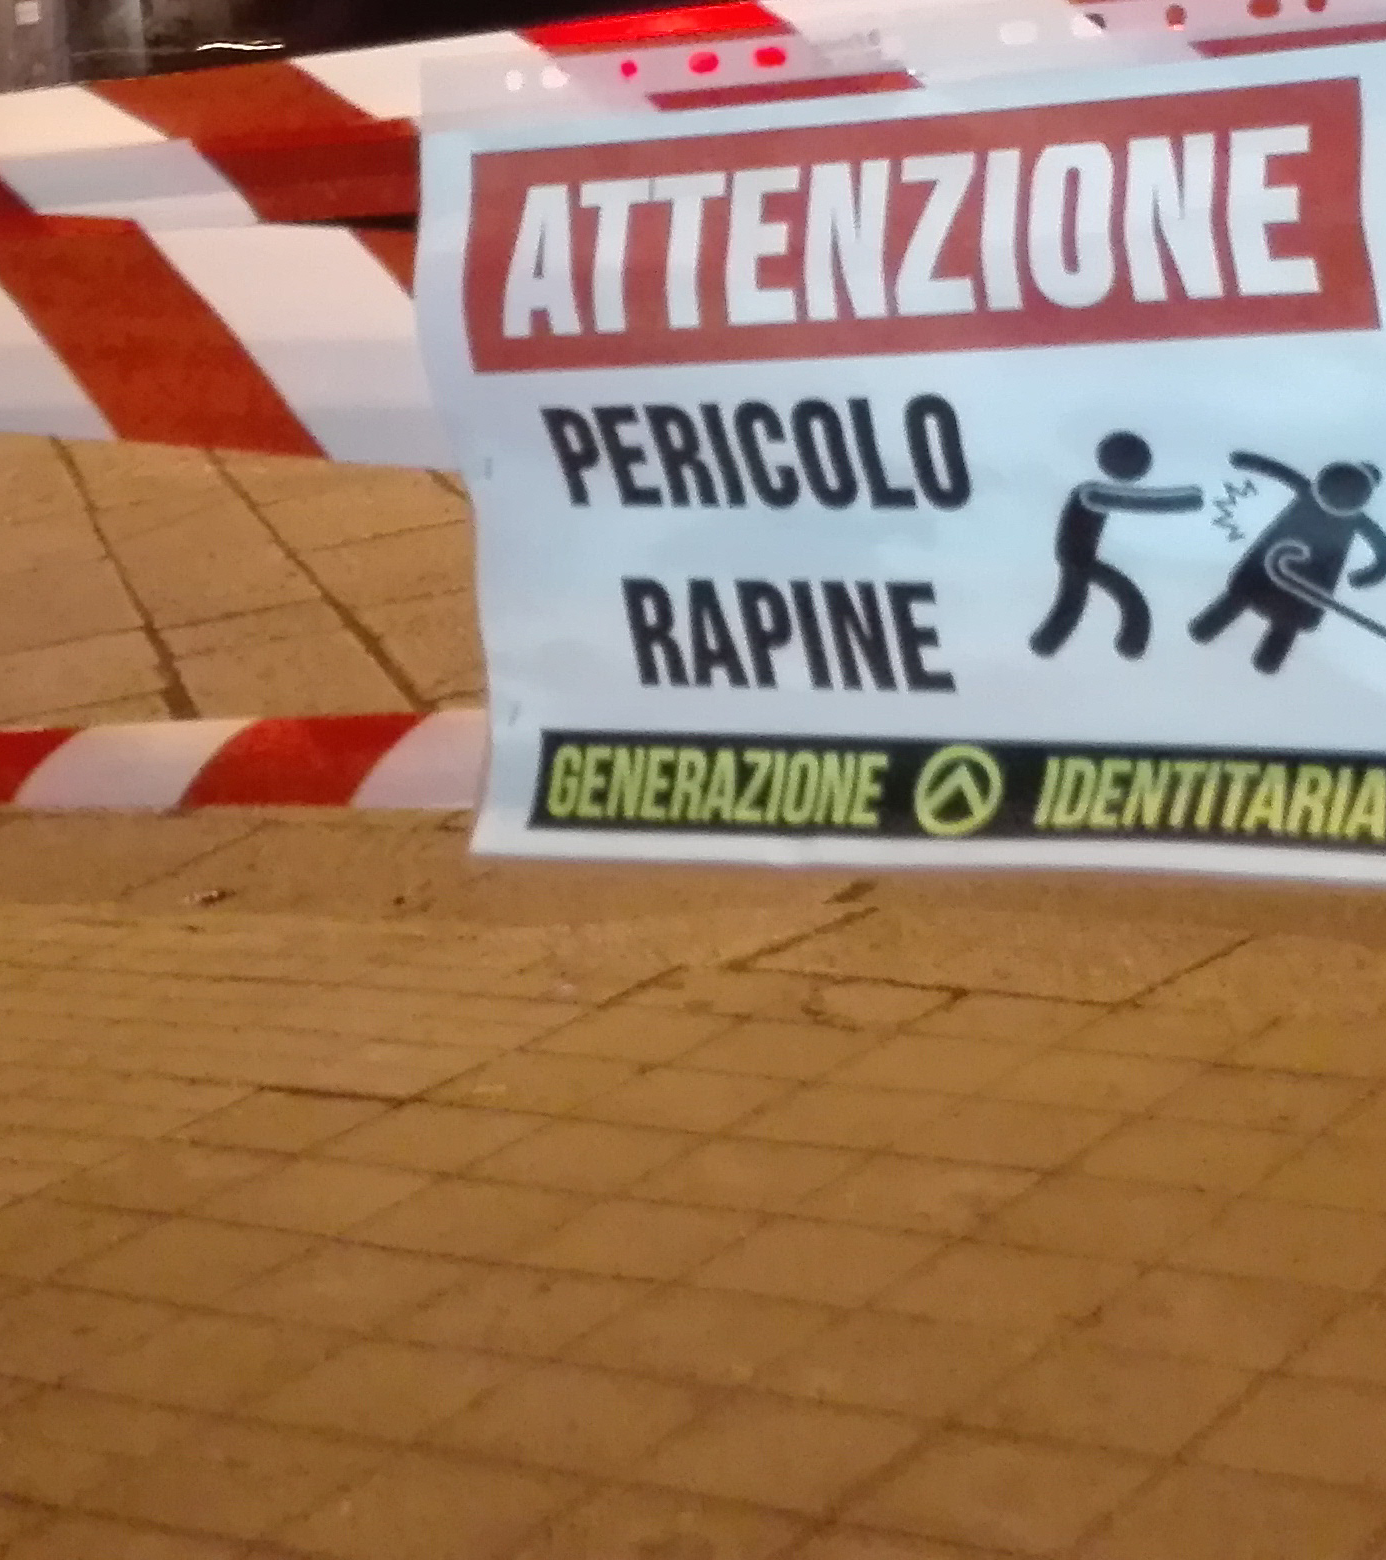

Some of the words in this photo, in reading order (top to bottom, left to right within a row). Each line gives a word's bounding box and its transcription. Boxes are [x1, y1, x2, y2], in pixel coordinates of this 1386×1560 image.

[501, 124, 1323, 341] ATTENZIONE
[540, 392, 973, 511] PERICOLO
[620, 576, 957, 694] RAPINE
[545, 744, 890, 829] GENERAZIONE
